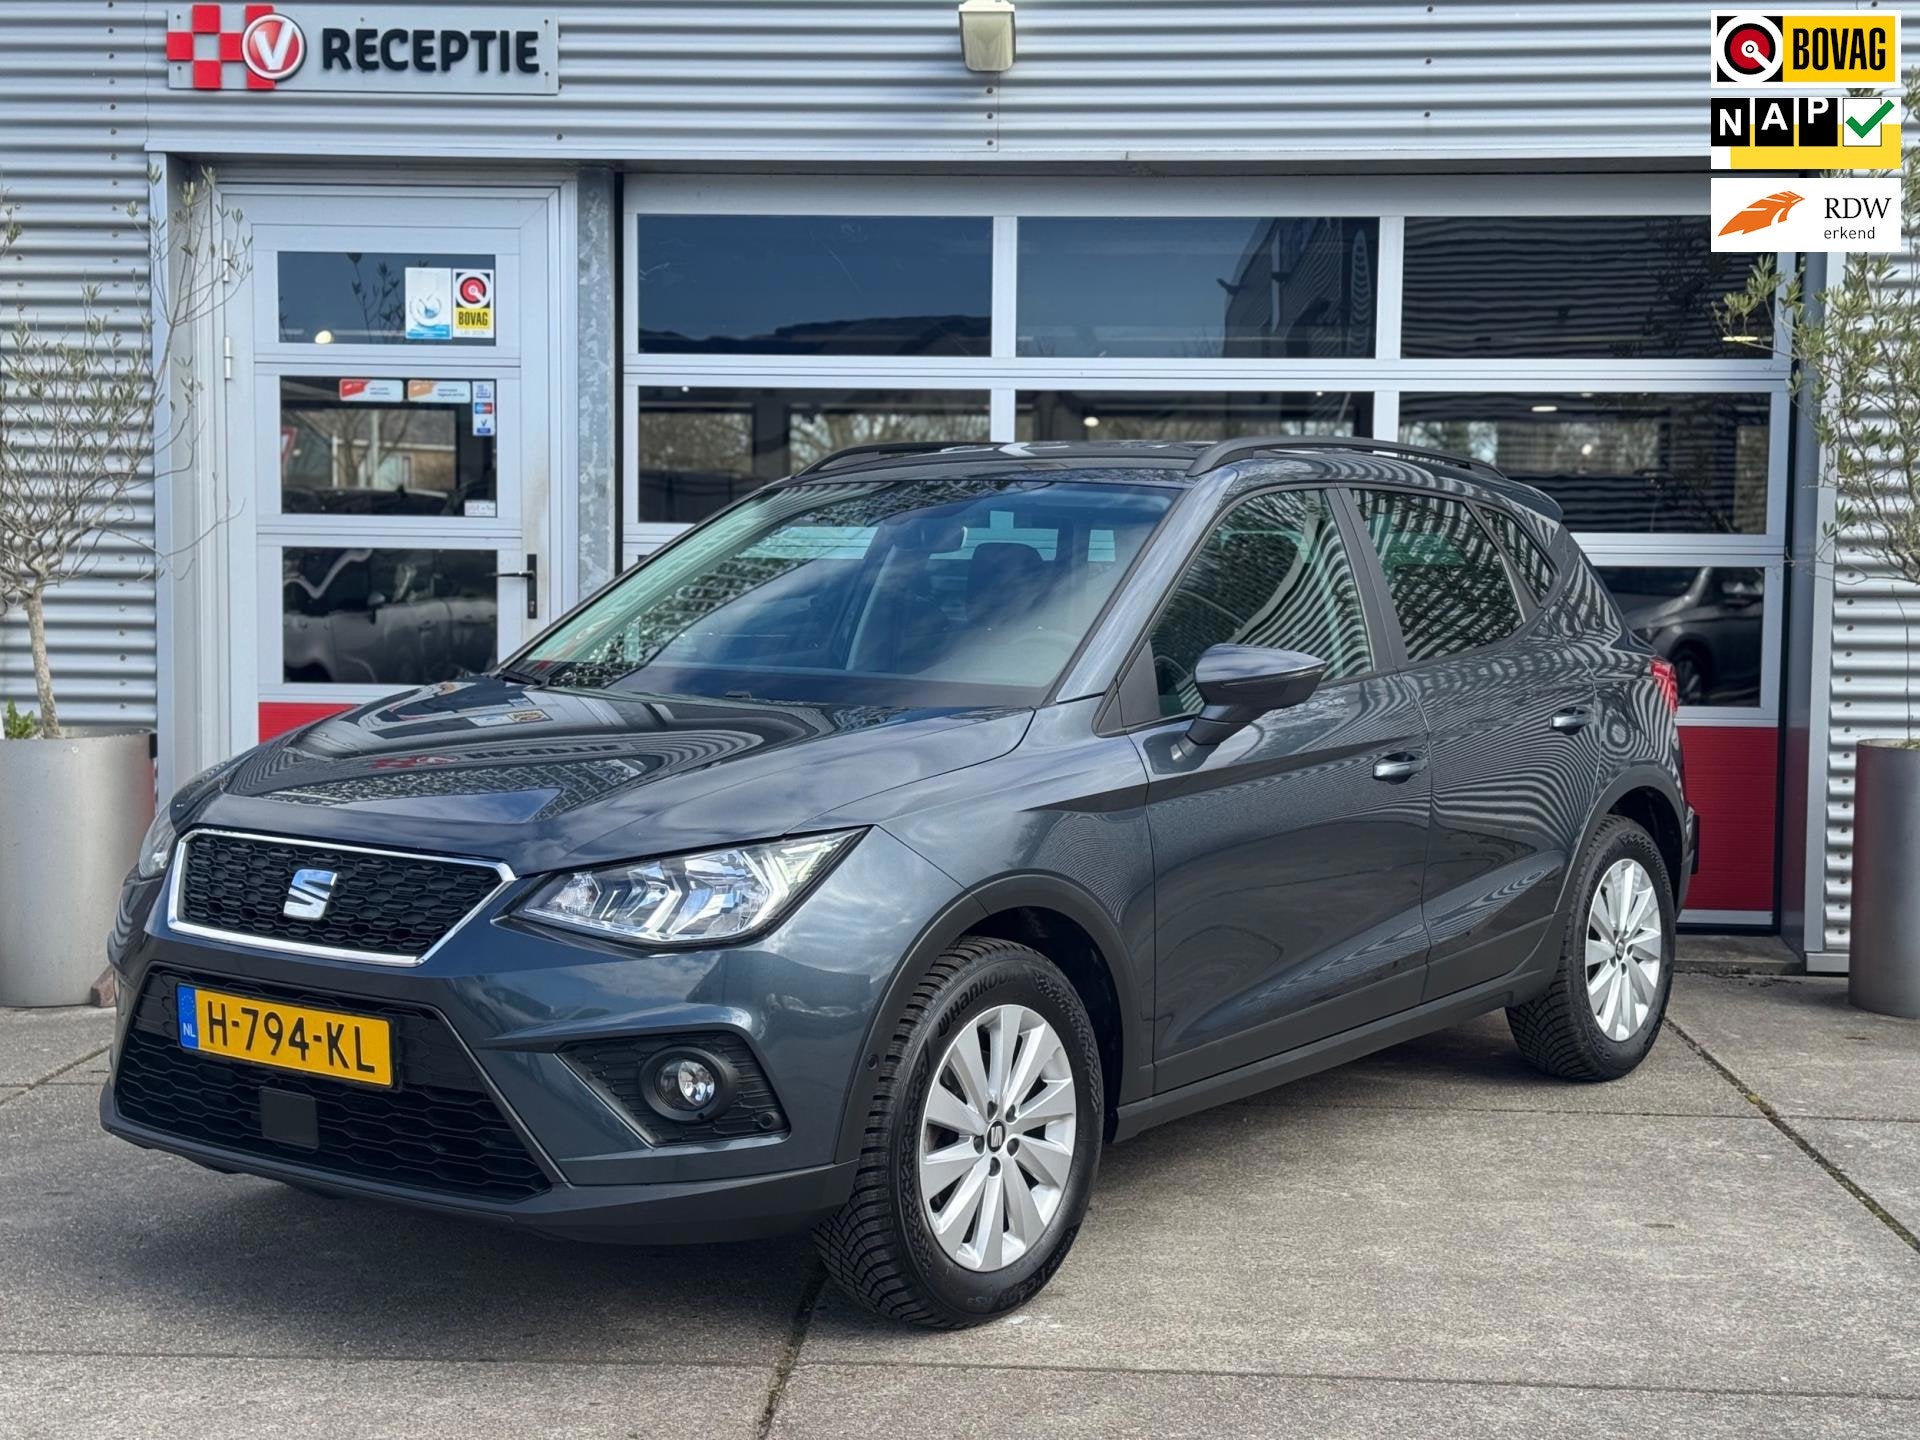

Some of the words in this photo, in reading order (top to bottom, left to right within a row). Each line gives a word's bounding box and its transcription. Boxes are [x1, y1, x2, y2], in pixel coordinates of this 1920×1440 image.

[322, 27, 541, 74] RECEPTIE
[458, 311, 489, 327] BOVAG
[183, 1021, 196, 1039] NL
[206, 1000, 376, 1074] H-794-KL
